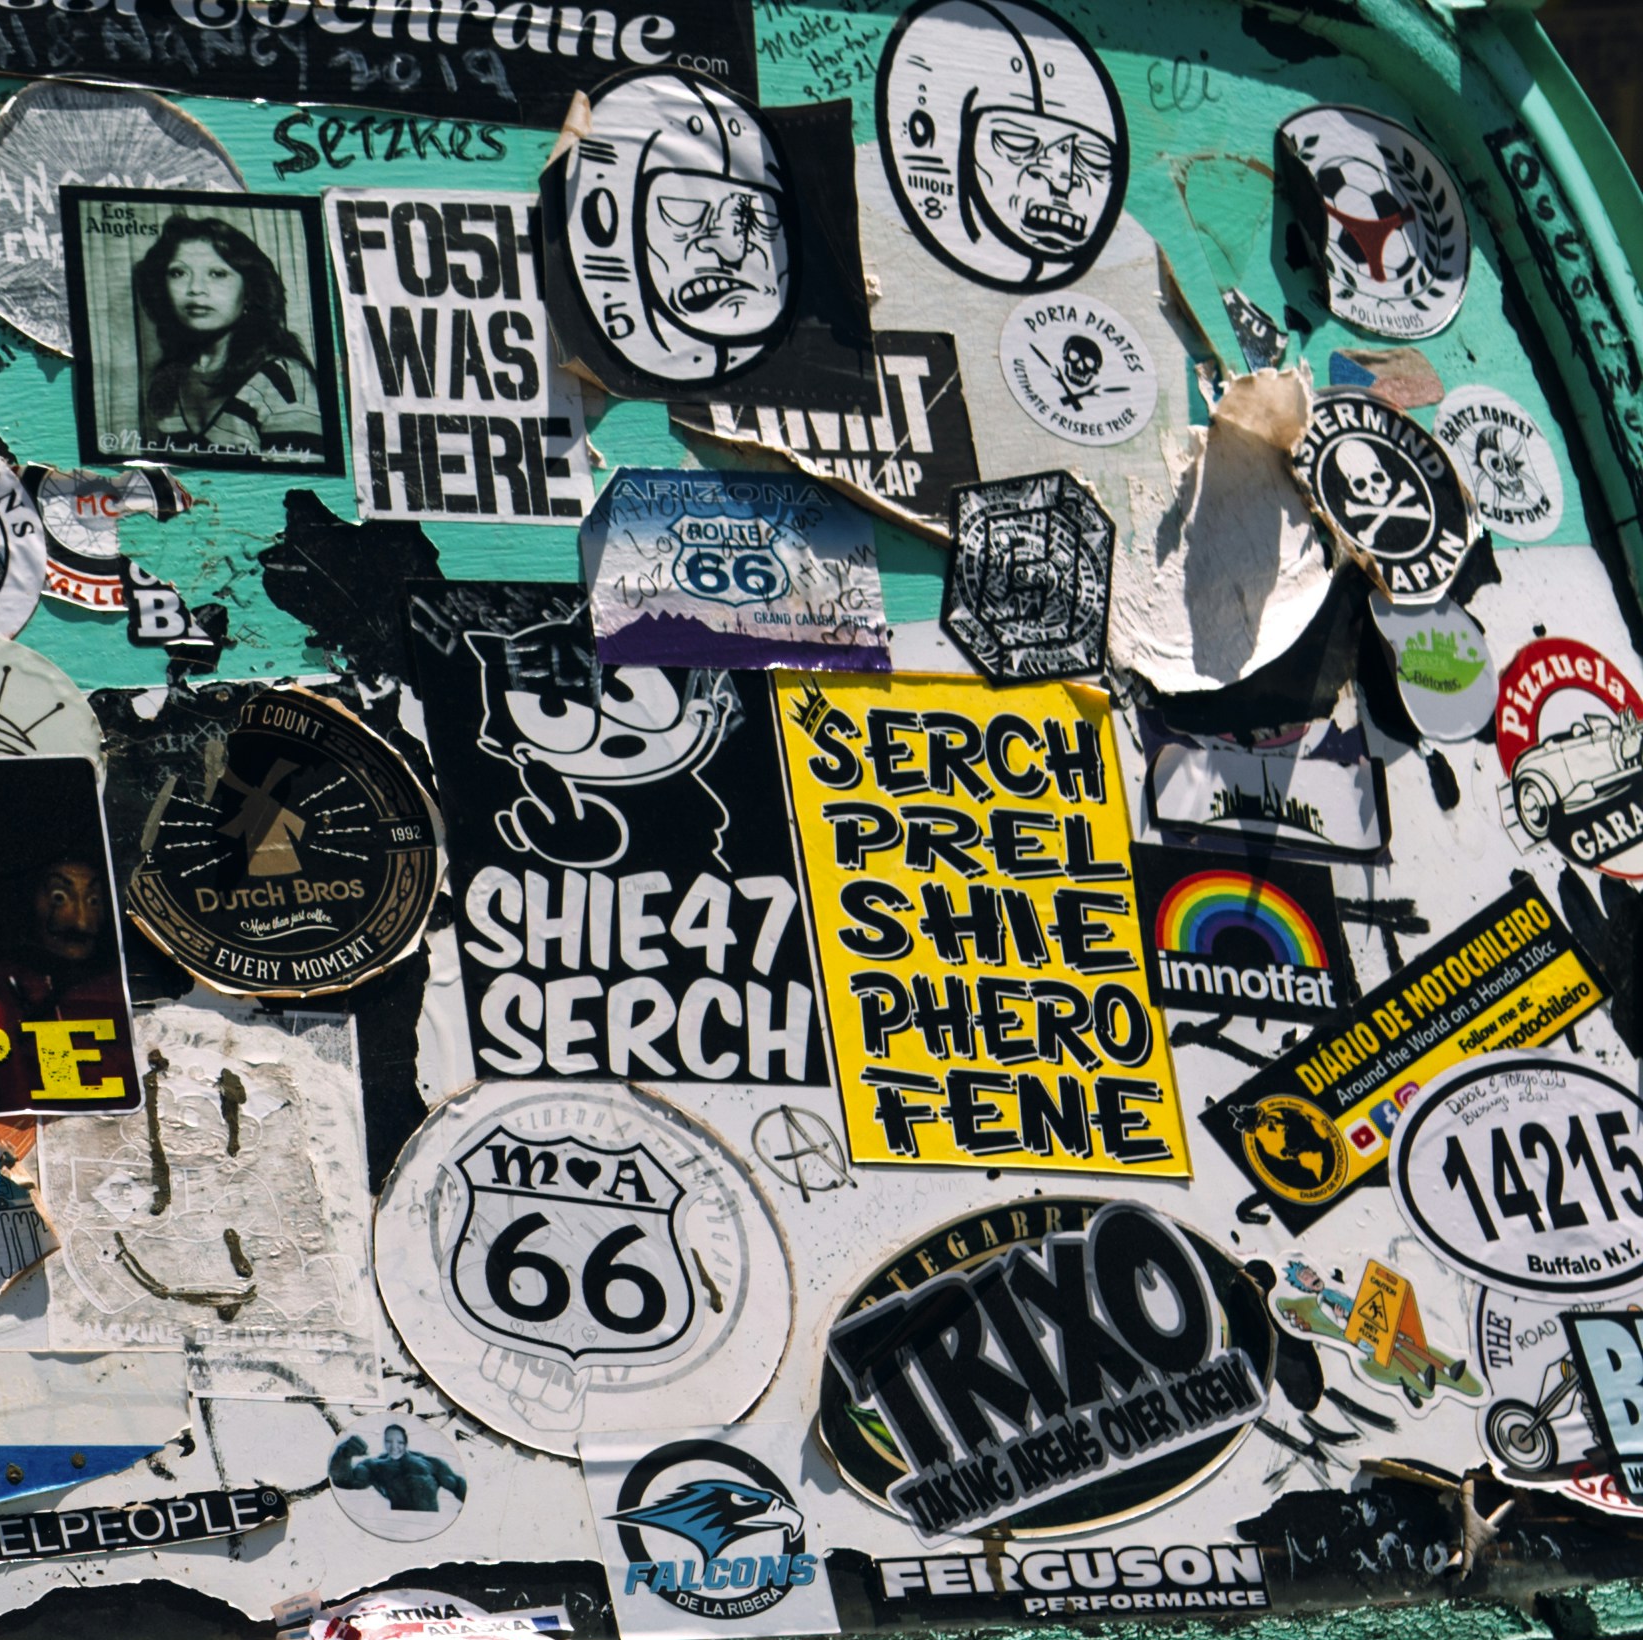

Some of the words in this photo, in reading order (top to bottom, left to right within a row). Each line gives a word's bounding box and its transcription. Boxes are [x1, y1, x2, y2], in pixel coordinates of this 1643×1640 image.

[86, 220, 161, 239] Angeles
[102, 203, 135, 220] Los
[365, 309, 540, 401] WAS
[367, 415, 582, 518] HERE
[687, 552, 778, 597] 66
[689, 523, 760, 542] ROUTE
[808, 704, 1108, 804] SERCH
[820, 802, 1131, 881] PREL
[197, 882, 293, 913] DUTCH
[302, 875, 365, 907] BROS
[465, 866, 800, 976] SHIE47
[837, 878, 1139, 979] SHIE
[851, 973, 1155, 1071] PHERO
[1159, 951, 1335, 1008] imnotfat
[1295, 1008, 1381, 1095] DIÁRIO
[1383, 986, 1413, 1036] DE
[1414, 898, 1551, 1011] MOTOCHILEIRO
[478, 976, 813, 1083] SERCH
[860, 1065, 1173, 1164] FENE
[1442, 1110, 1643, 1243] 14215
[485, 1211, 669, 1336] 66
[1528, 1254, 1601, 1276] Buffalo
[1604, 1238, 1641, 1269] N.Y.
[624, 1552, 817, 1597] FALCONS
[880, 1544, 1263, 1598] FERGUSON
[1023, 1590, 1268, 1614] PERFORMANCE
